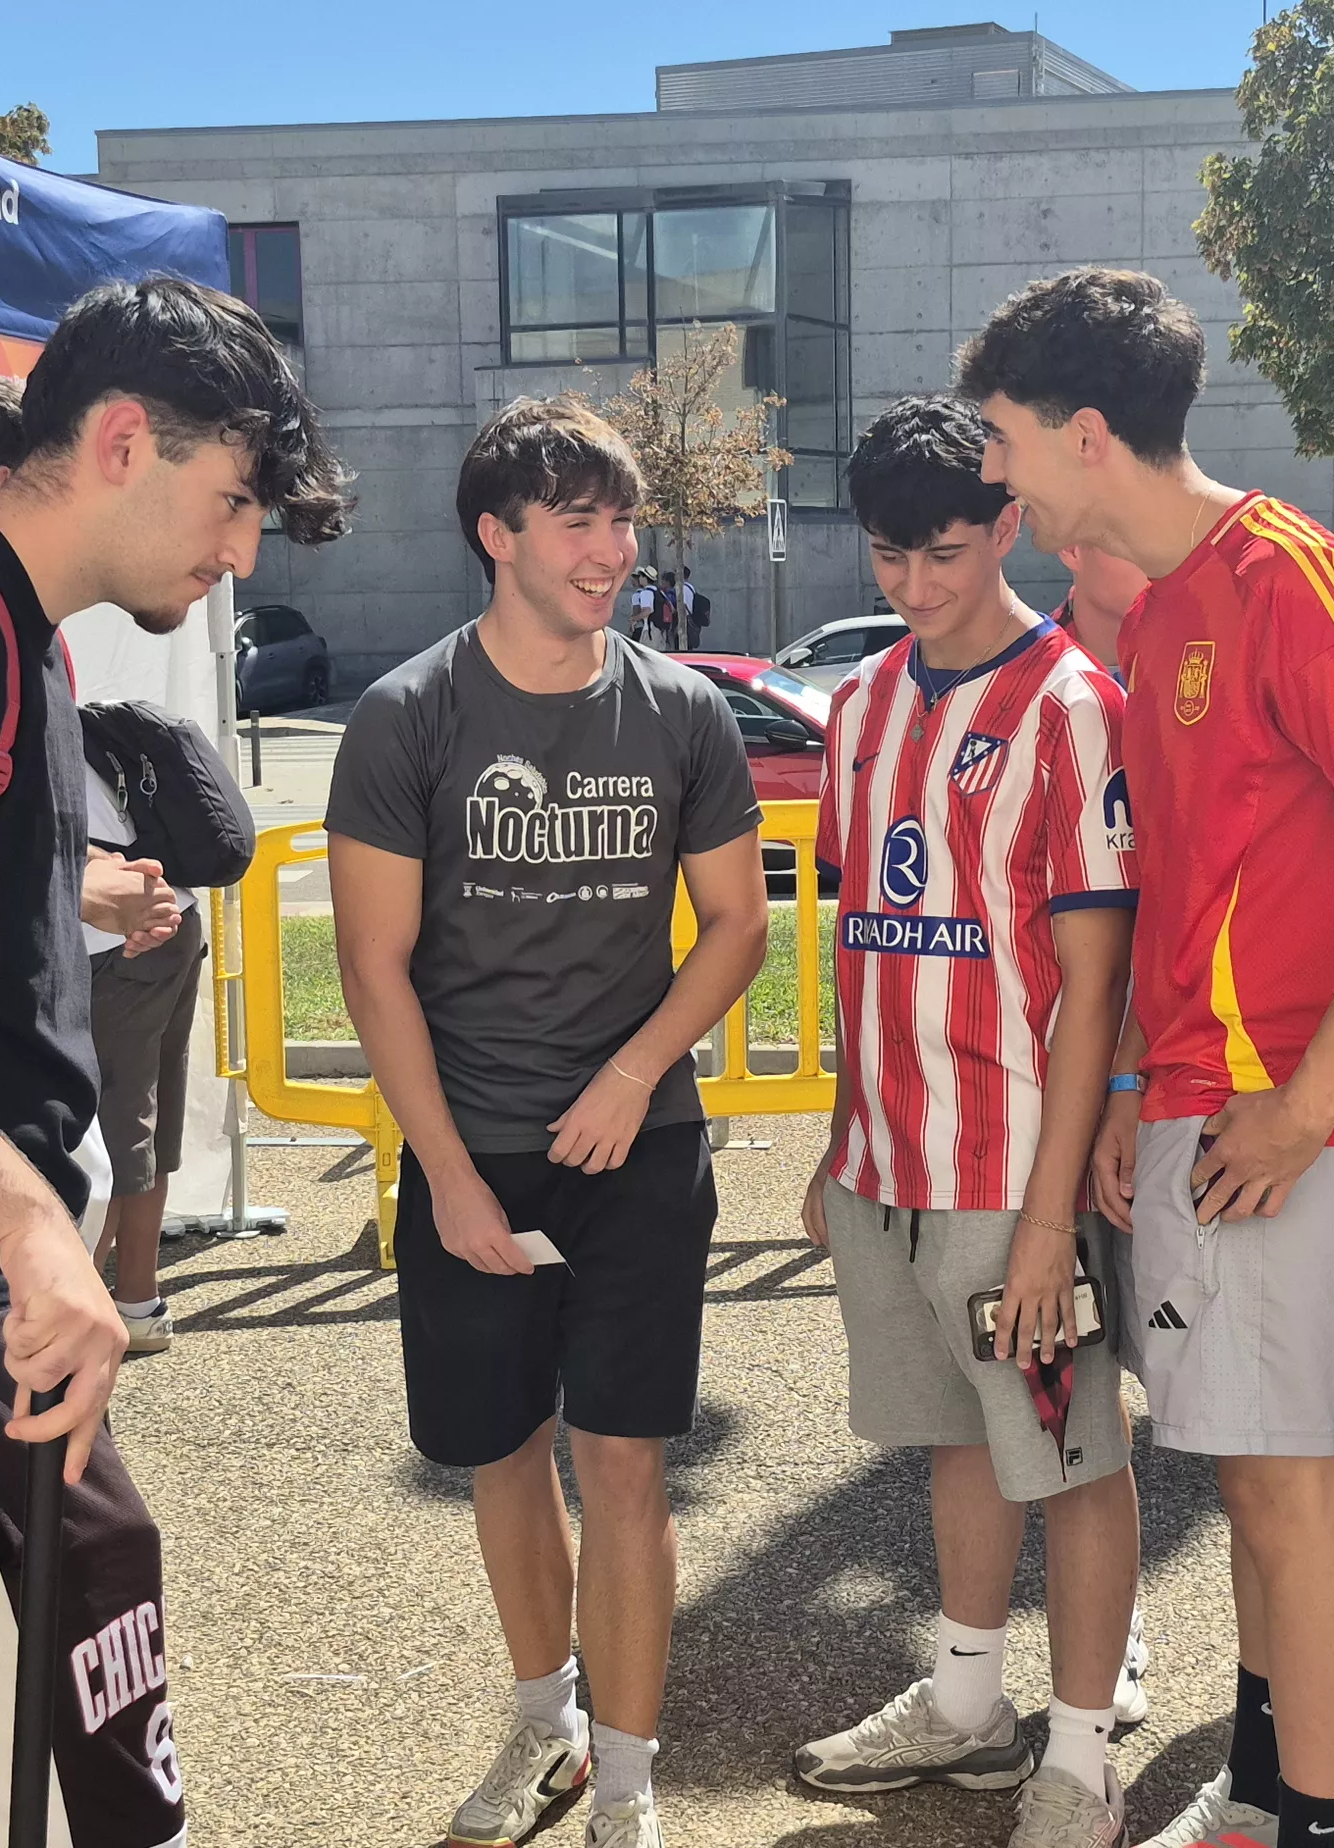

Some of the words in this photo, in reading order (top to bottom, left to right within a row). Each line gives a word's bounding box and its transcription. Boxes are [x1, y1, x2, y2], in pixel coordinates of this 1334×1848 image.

[567, 771, 653, 799] Carrera
[466, 797, 657, 863] Nocturna
[1106, 832, 1135, 850] kra
[929, 923, 985, 952] AIR
